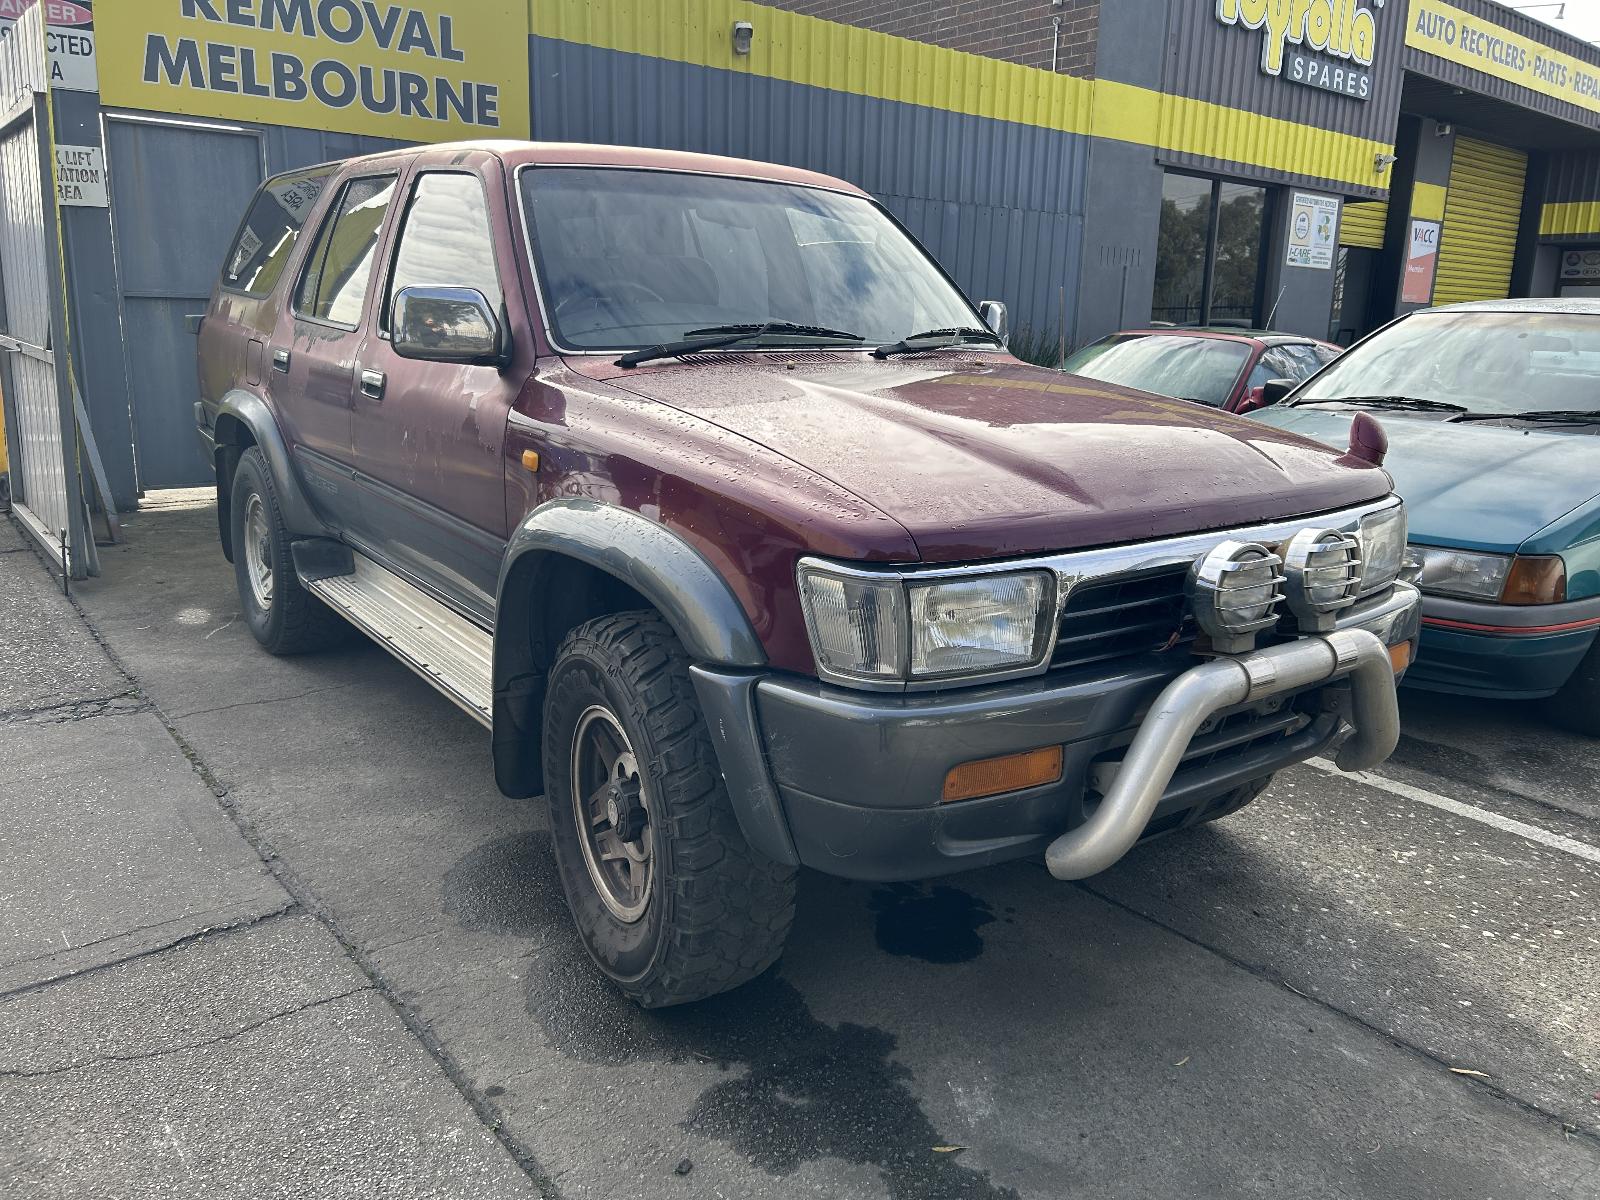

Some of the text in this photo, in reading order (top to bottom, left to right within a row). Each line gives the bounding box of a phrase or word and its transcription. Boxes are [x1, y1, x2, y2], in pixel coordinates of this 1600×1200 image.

[1415, 9, 1456, 46] AUTO
[1460, 25, 1527, 72] RECYCLERS
[1533, 55, 1568, 88] PARTS
[143, 33, 500, 127] MELBOURNE
[1293, 57, 1369, 97] SPARES
[65, 150, 92, 166] LIFT
[57, 167, 100, 184] ATION
[58, 184, 83, 200] REA
[1414, 227, 1435, 244] VACC
